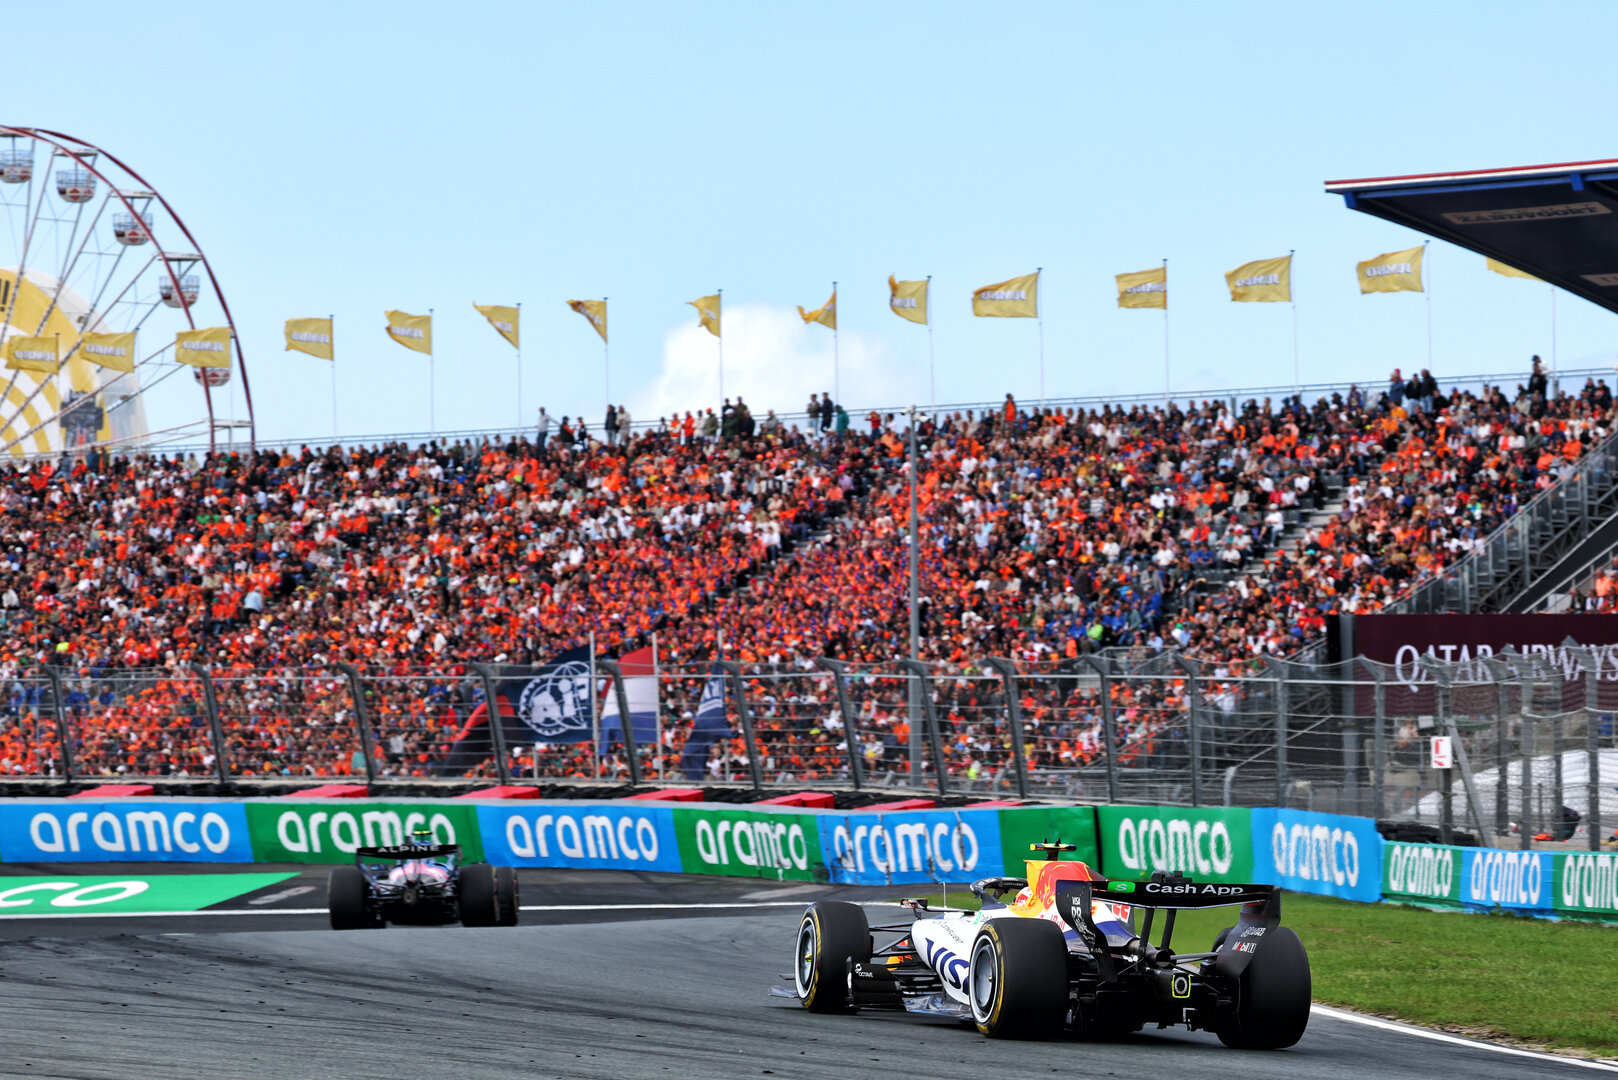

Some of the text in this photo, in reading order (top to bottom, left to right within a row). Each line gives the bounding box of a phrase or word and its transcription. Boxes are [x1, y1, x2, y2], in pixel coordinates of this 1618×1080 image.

[1395, 644, 1495, 693] QATAR
[29, 812, 231, 854] aramco
[277, 811, 457, 853] aramco
[377, 845, 440, 853] ALPINE
[505, 814, 659, 862] aramco
[698, 819, 808, 870] aramco
[833, 821, 980, 873] aramco
[1118, 817, 1233, 875] aramco
[1271, 821, 1359, 887] aramco
[1145, 882, 1244, 895] Cash App
[1389, 844, 1454, 897] aramco
[1470, 851, 1541, 905] aramco
